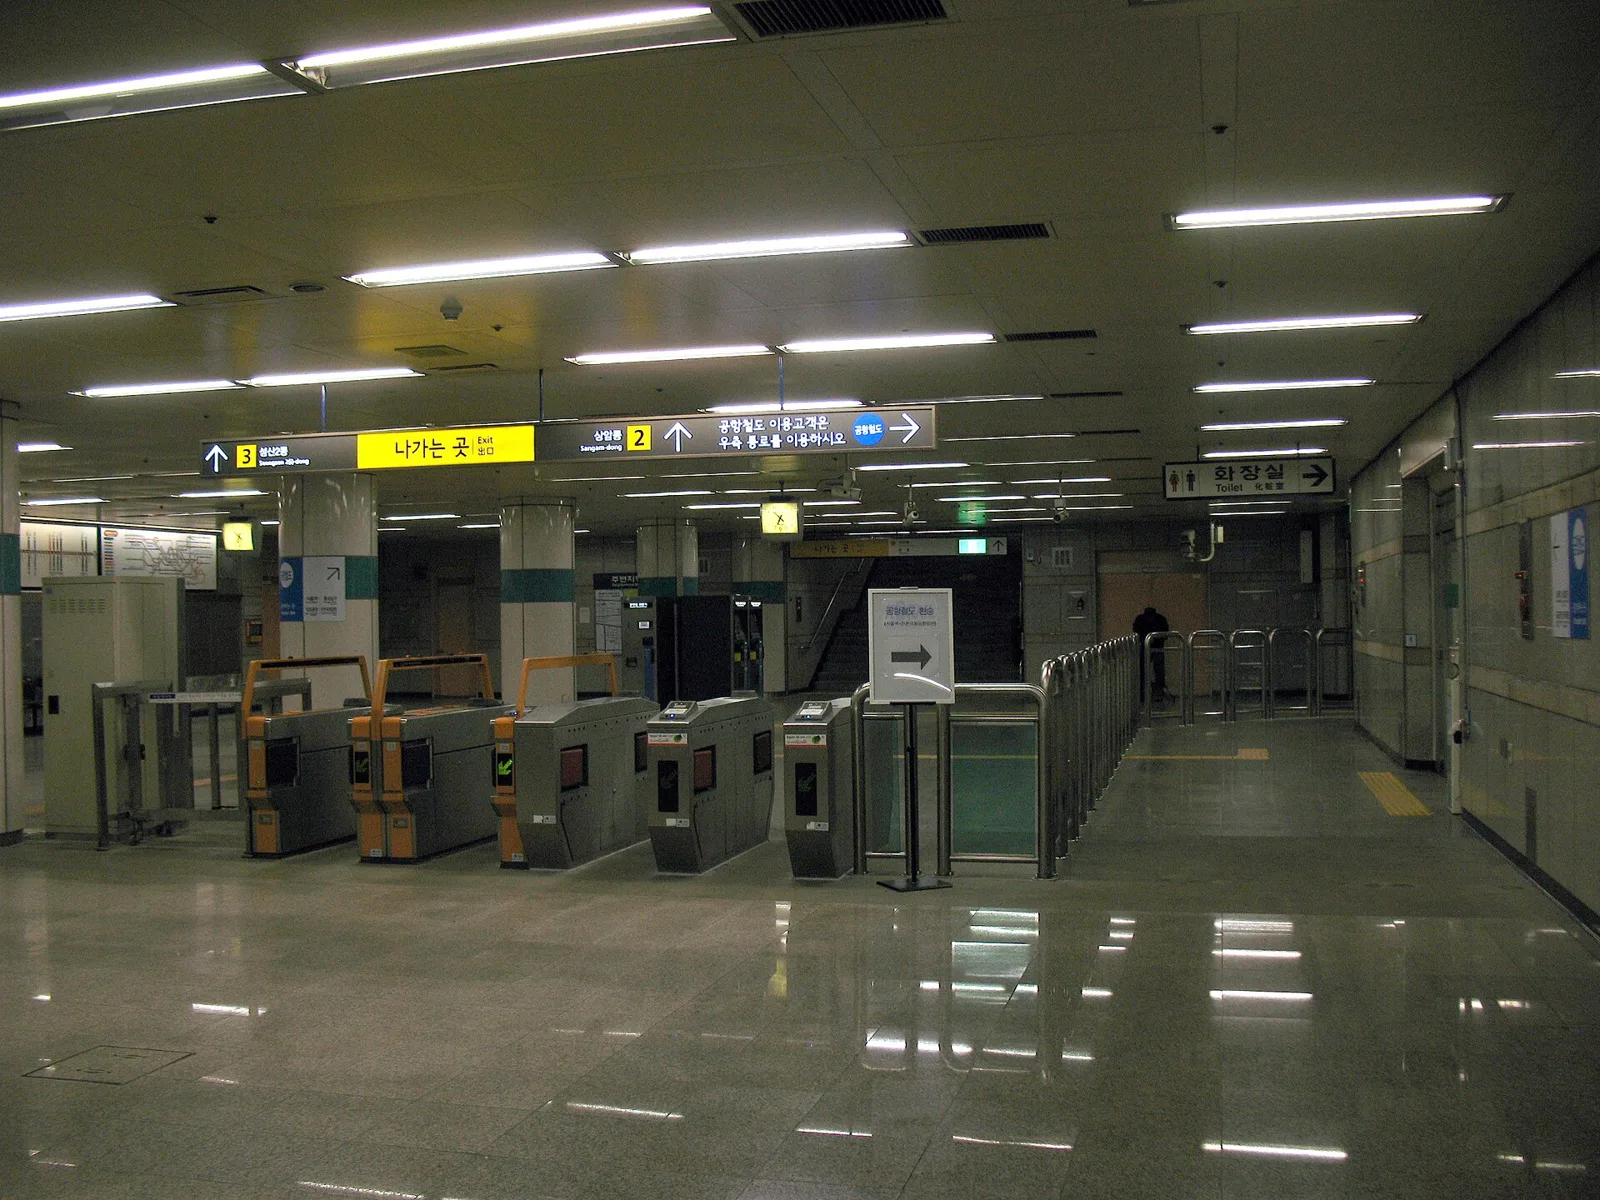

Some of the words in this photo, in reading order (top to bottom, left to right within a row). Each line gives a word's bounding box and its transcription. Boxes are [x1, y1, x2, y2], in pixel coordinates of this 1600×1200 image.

[718, 418, 765, 434] 공항철도
[770, 415, 829, 431] 이용고객은
[477, 436, 494, 445] Exit
[594, 429, 622, 442] 상암동
[634, 429, 645, 446] 2
[718, 436, 742, 450] 우측
[747, 433, 782, 449] 통로를
[787, 431, 847, 447] 이용하시오
[242, 448, 252, 465] 3
[395, 438, 446, 460] 나가는
[452, 437, 470, 458] 곳
[478, 446, 494, 456] 出口
[580, 444, 622, 452] Sangam-dong
[1214, 463, 1284, 482] 화장실
[1215, 483, 1244, 493] Toilet
